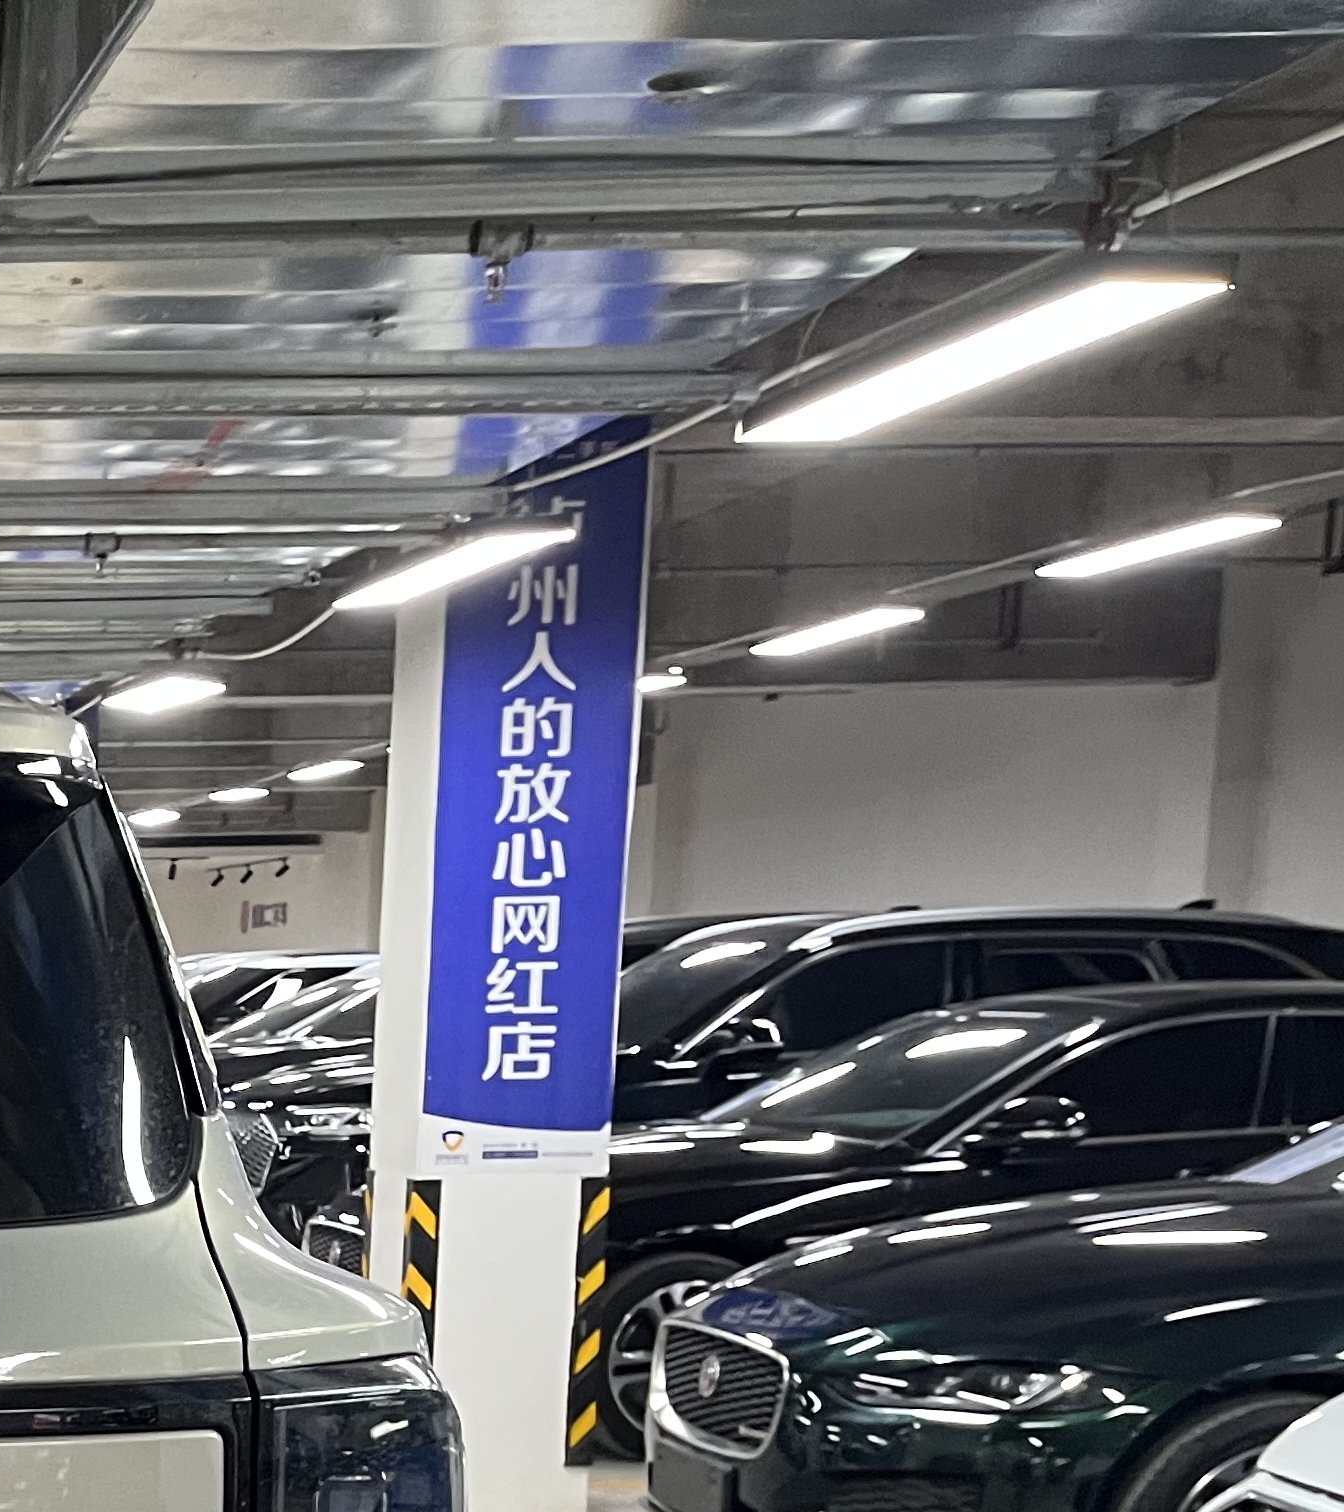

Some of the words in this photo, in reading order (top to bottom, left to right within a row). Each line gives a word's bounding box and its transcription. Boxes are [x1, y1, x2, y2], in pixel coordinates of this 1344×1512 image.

[482, 496, 586, 1082] 州人的放心网红店
